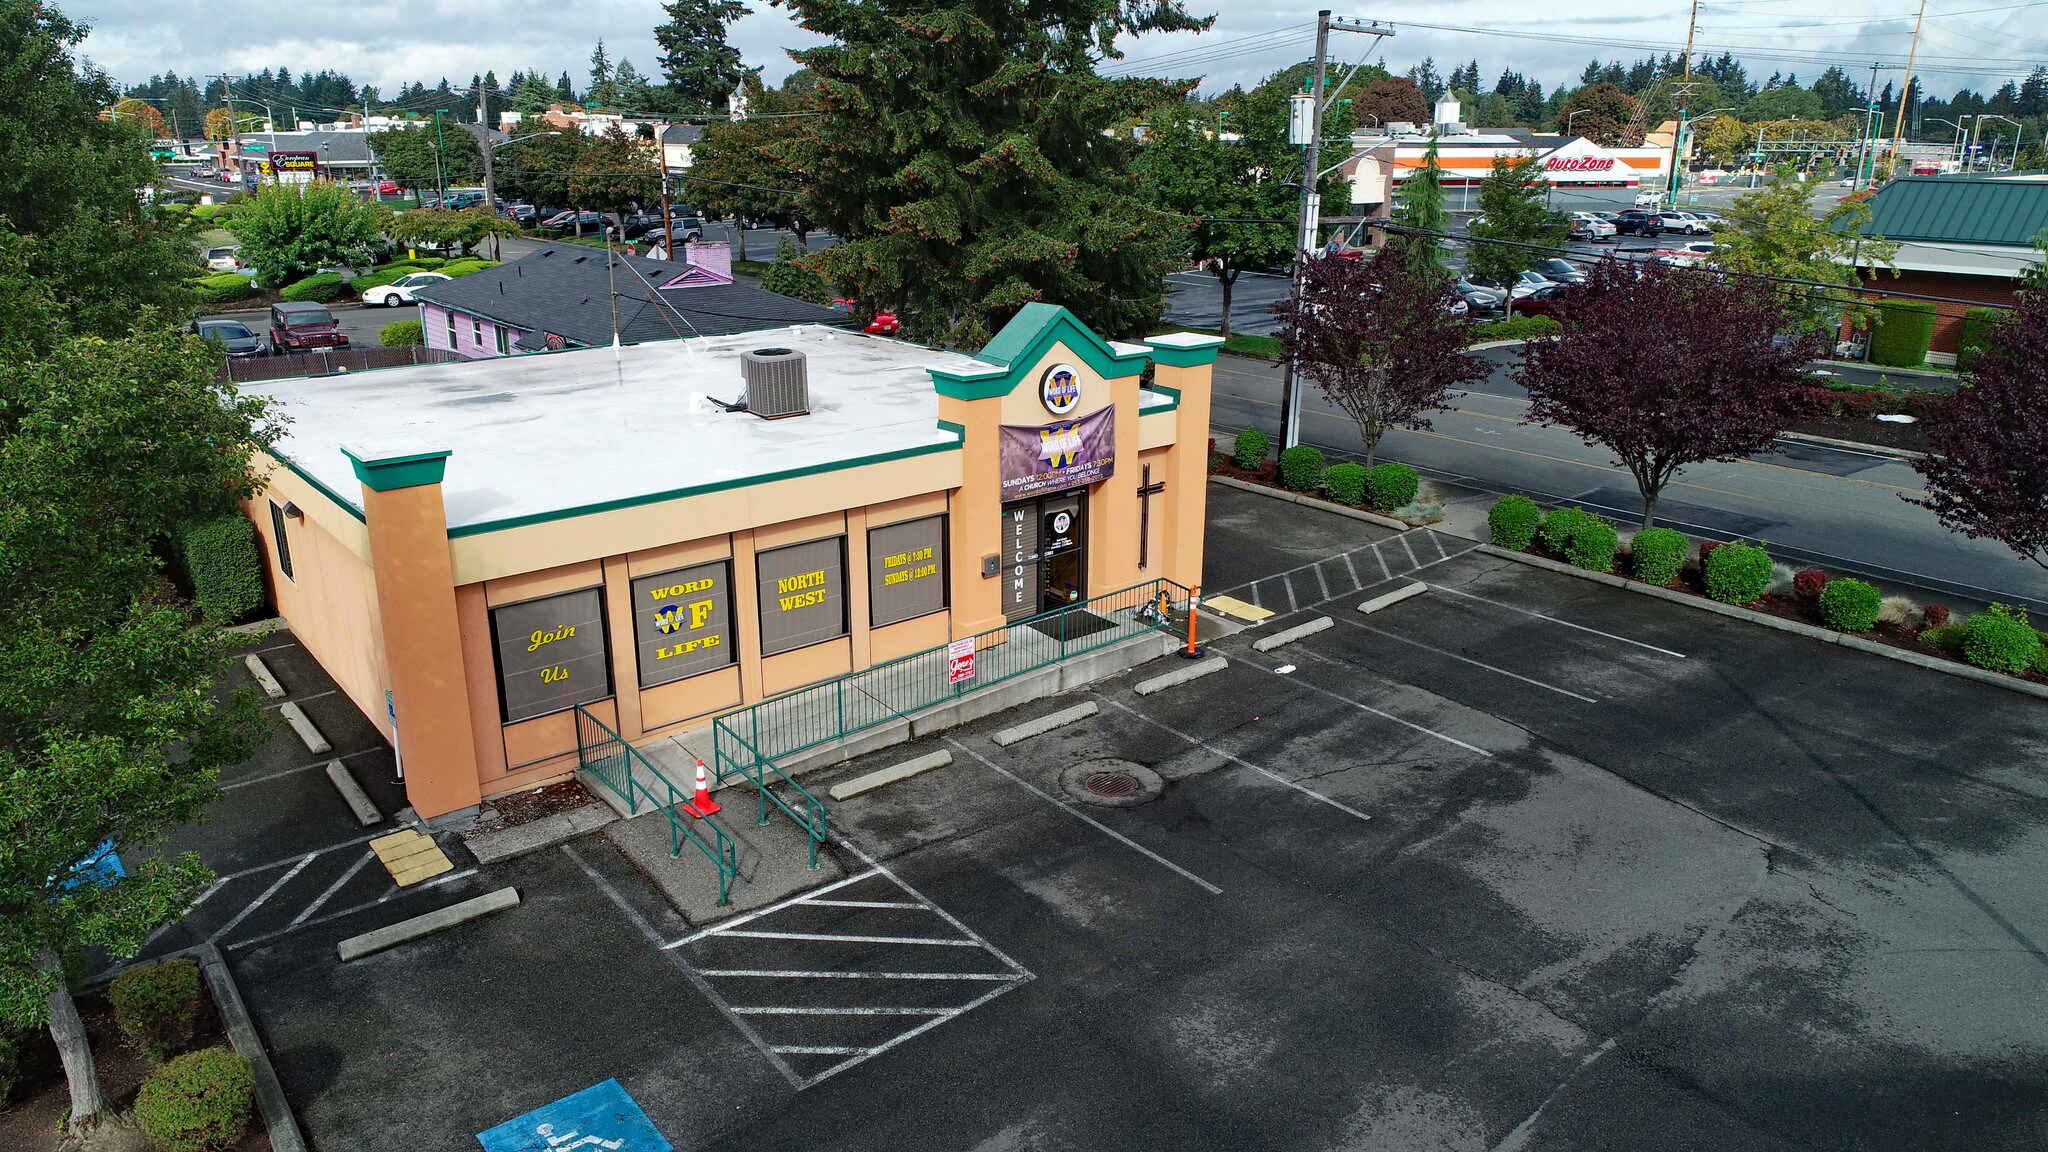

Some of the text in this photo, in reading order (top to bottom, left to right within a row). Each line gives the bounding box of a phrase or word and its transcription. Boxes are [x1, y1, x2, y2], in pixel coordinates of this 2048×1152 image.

[1545, 156, 1615, 171] AutoZone
[1040, 434, 1082, 454] WORD OF LIFE
[1003, 474, 1035, 488] SUNDAYS
[1066, 461, 1093, 475] FRIDAYS
[1024, 480, 1047, 491] CHURCH
[1047, 477, 1067, 486] WHERE
[1067, 474, 1078, 482] YOU
[884, 547, 933, 568] FRIDAYS @ 7:30 PM
[1014, 510, 1025, 603] WELCOME
[777, 570, 826, 595] NORTH
[884, 563, 936, 586] SUNDAYS @ 12:00 PM
[650, 578, 714, 600] WORD
[779, 588, 827, 612] WEST
[688, 599, 713, 630] F
[527, 624, 576, 652] Join
[656, 634, 720, 660] LIFE
[540, 665, 569, 684] Us
